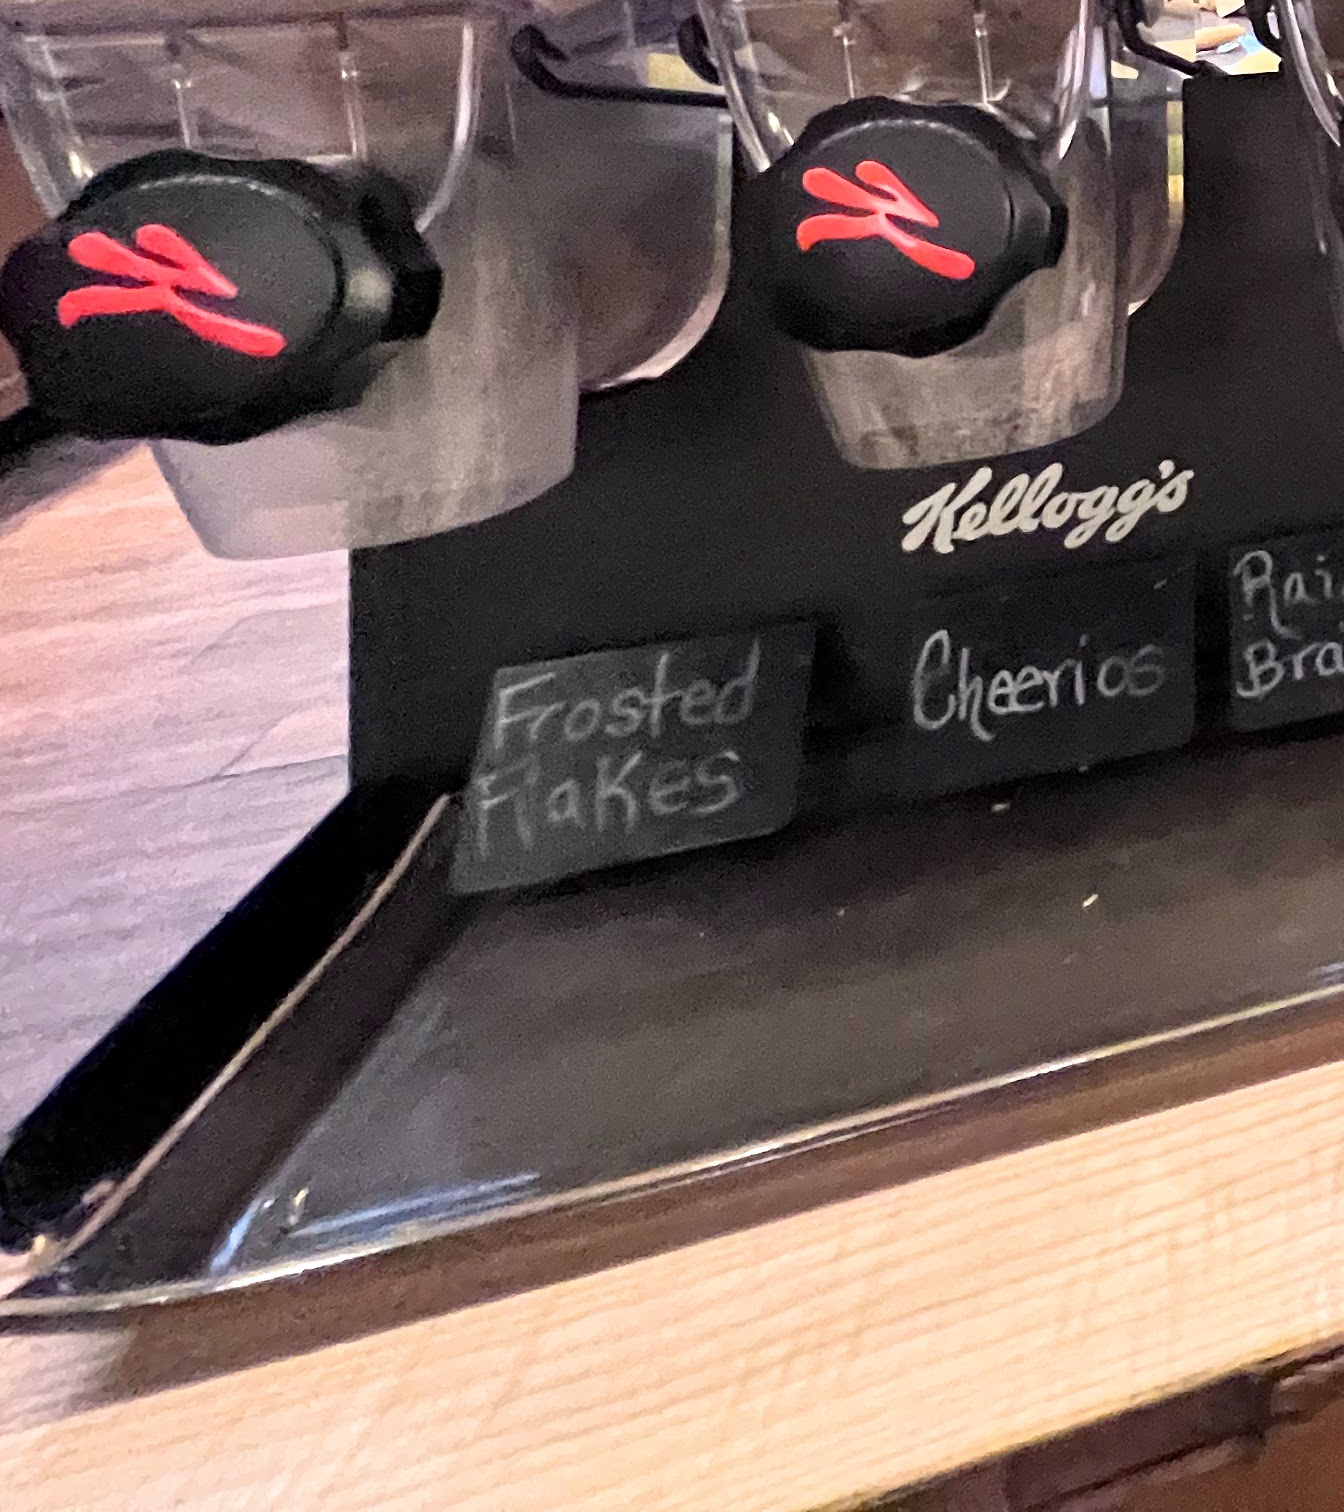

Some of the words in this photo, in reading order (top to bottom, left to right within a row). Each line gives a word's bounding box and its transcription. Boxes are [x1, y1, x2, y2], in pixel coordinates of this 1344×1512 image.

[901, 459, 1195, 554] Kellogg's
[493, 640, 761, 750] Frosted
[912, 629, 1167, 741] Cheerios
